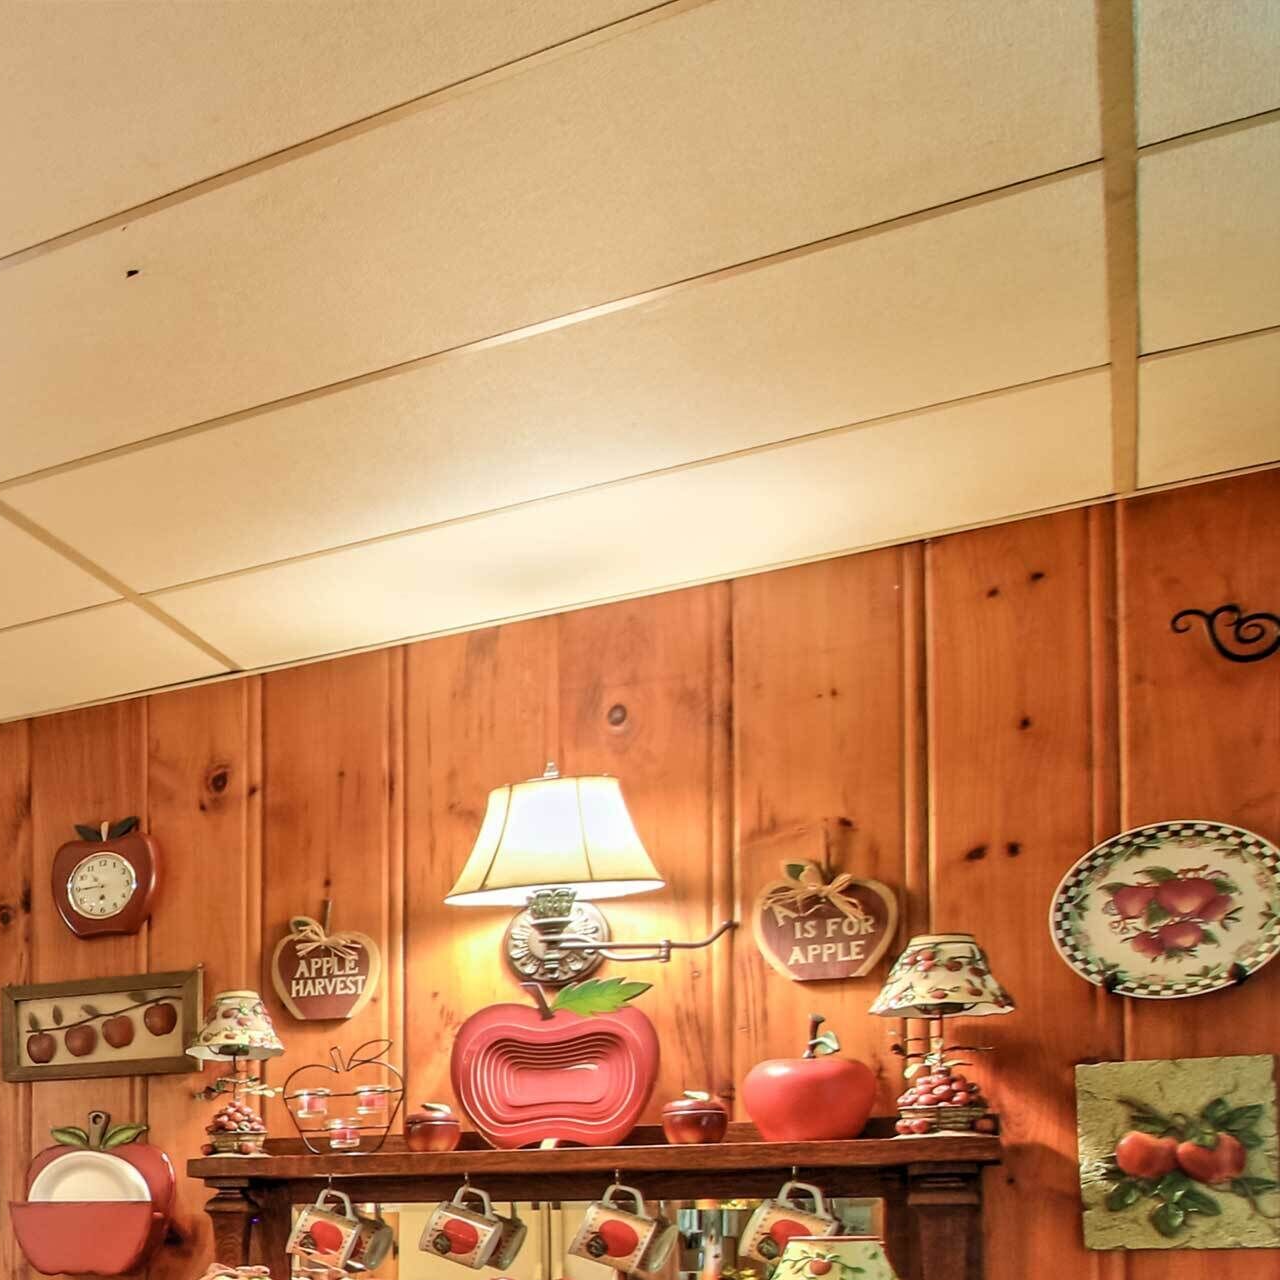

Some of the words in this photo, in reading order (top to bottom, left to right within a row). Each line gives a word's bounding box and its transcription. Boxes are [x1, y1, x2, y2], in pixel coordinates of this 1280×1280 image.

[794, 920, 817, 940] IS
[825, 915, 876, 938] FOR
[787, 941, 865, 966] APPLE
[294, 957, 359, 978] APPLE
[291, 976, 366, 998] HARVEST
